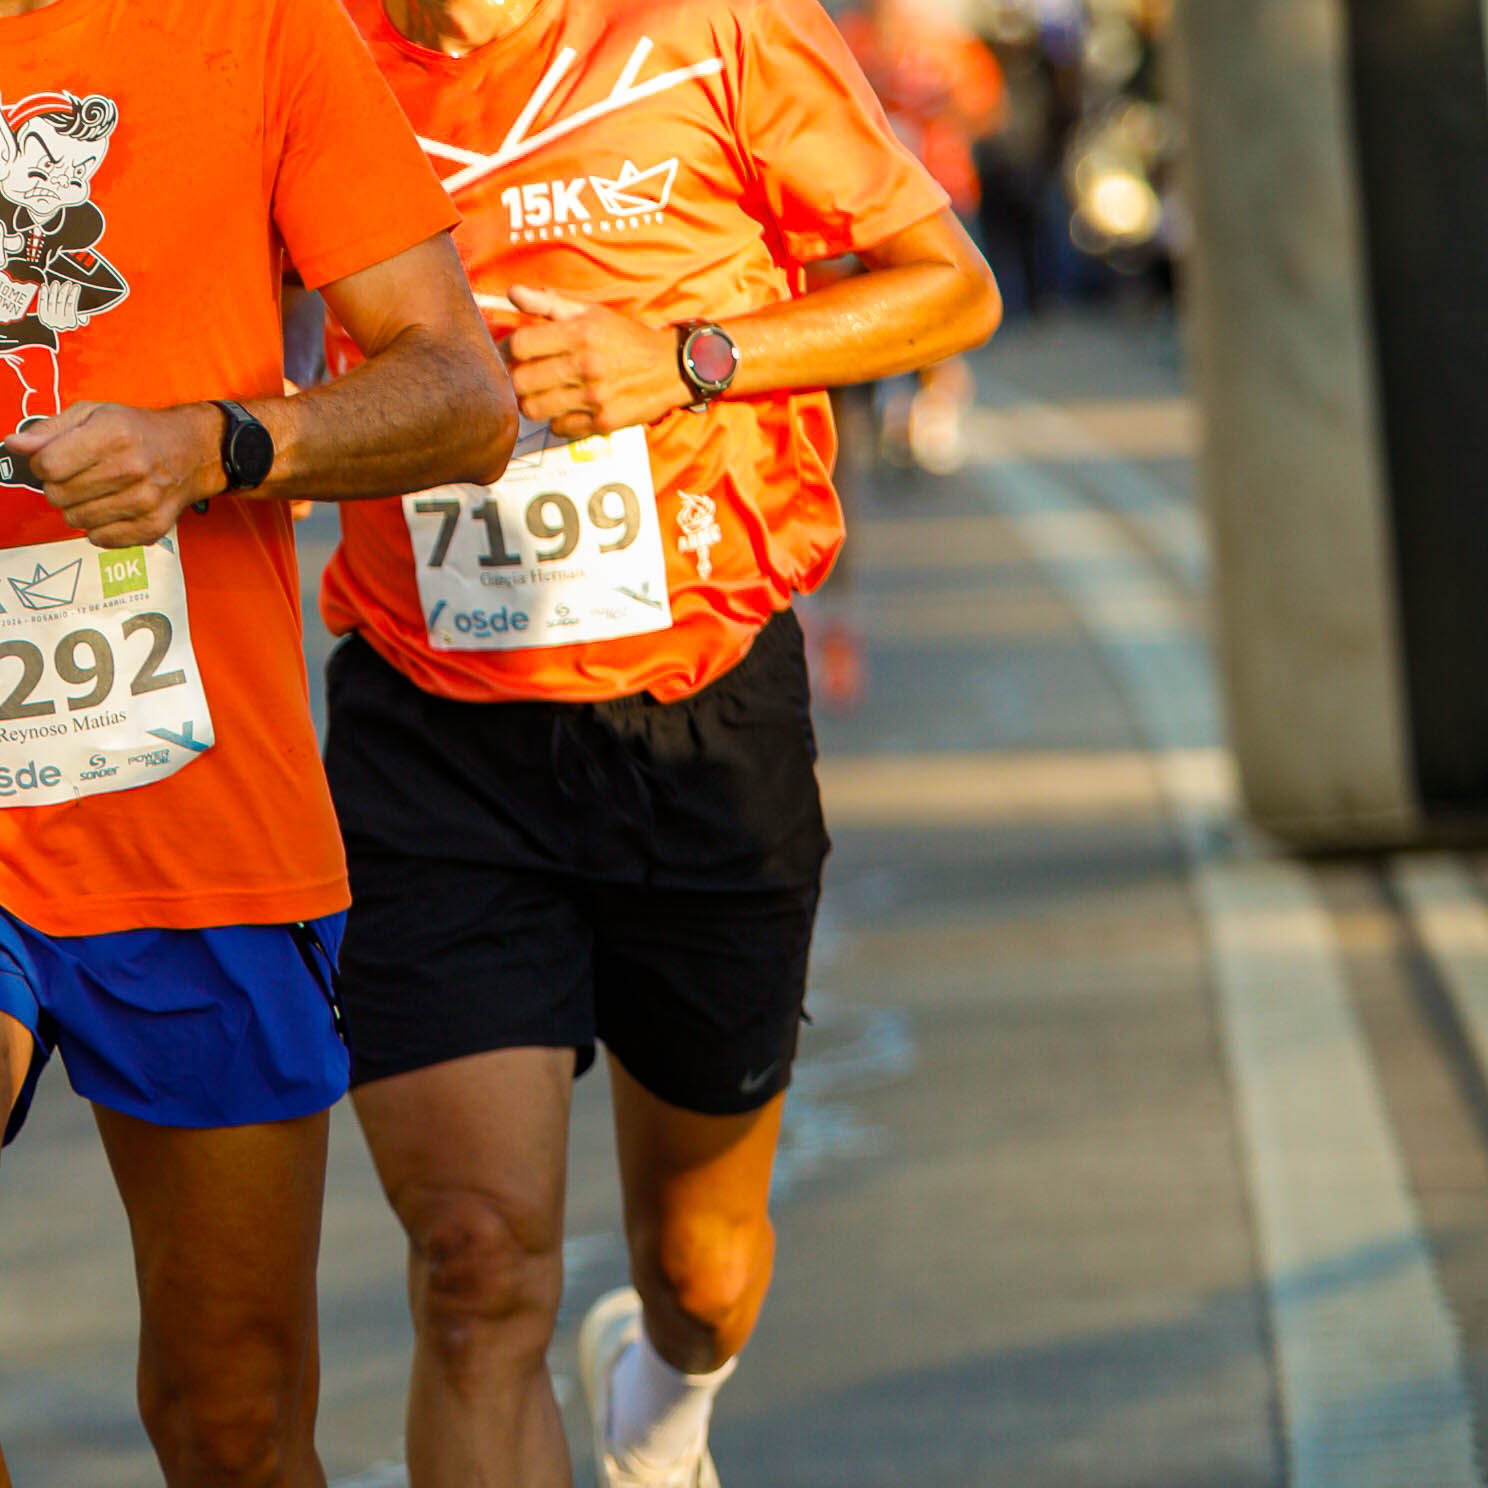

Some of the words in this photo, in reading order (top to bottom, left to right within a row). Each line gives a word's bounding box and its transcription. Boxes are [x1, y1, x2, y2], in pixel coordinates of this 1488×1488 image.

[501, 177, 591, 230] 15K
[413, 482, 641, 567] 7199
[103, 558, 143, 584] 10K
[454, 605, 529, 638] osde
